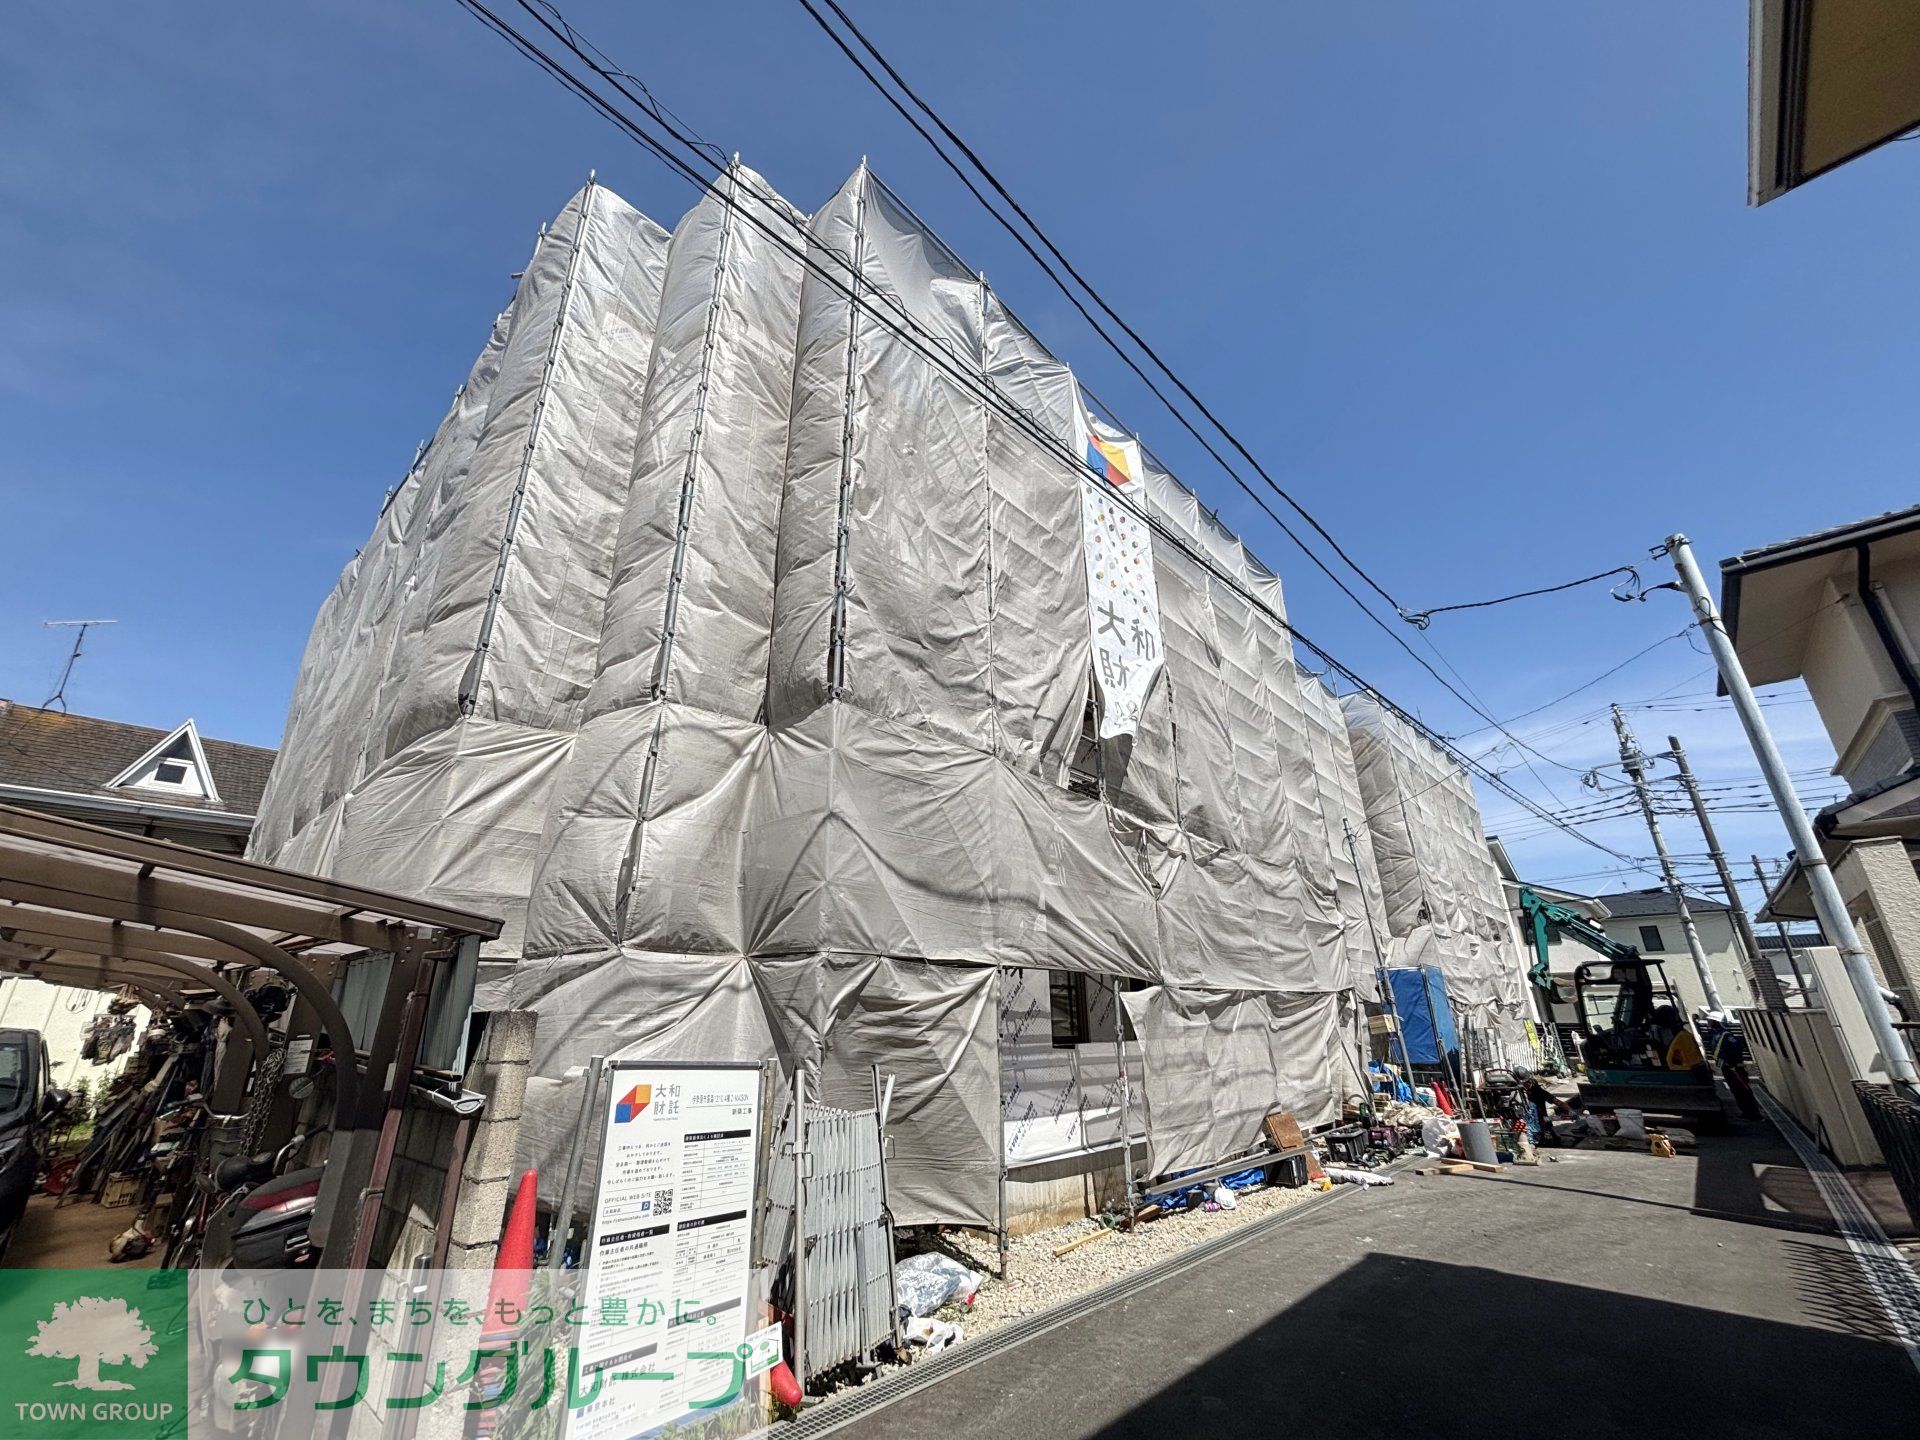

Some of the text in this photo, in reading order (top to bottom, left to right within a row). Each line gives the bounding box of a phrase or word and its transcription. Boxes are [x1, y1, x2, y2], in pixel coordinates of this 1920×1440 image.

[1098, 600, 1156, 662] 大和
[1099, 647, 1142, 691] 財
[655, 1083, 681, 1098] 大和
[654, 1100, 680, 1115] 財託
[604, 1196, 628, 1204] OFFICIAL
[641, 1191, 652, 1199] SITE
